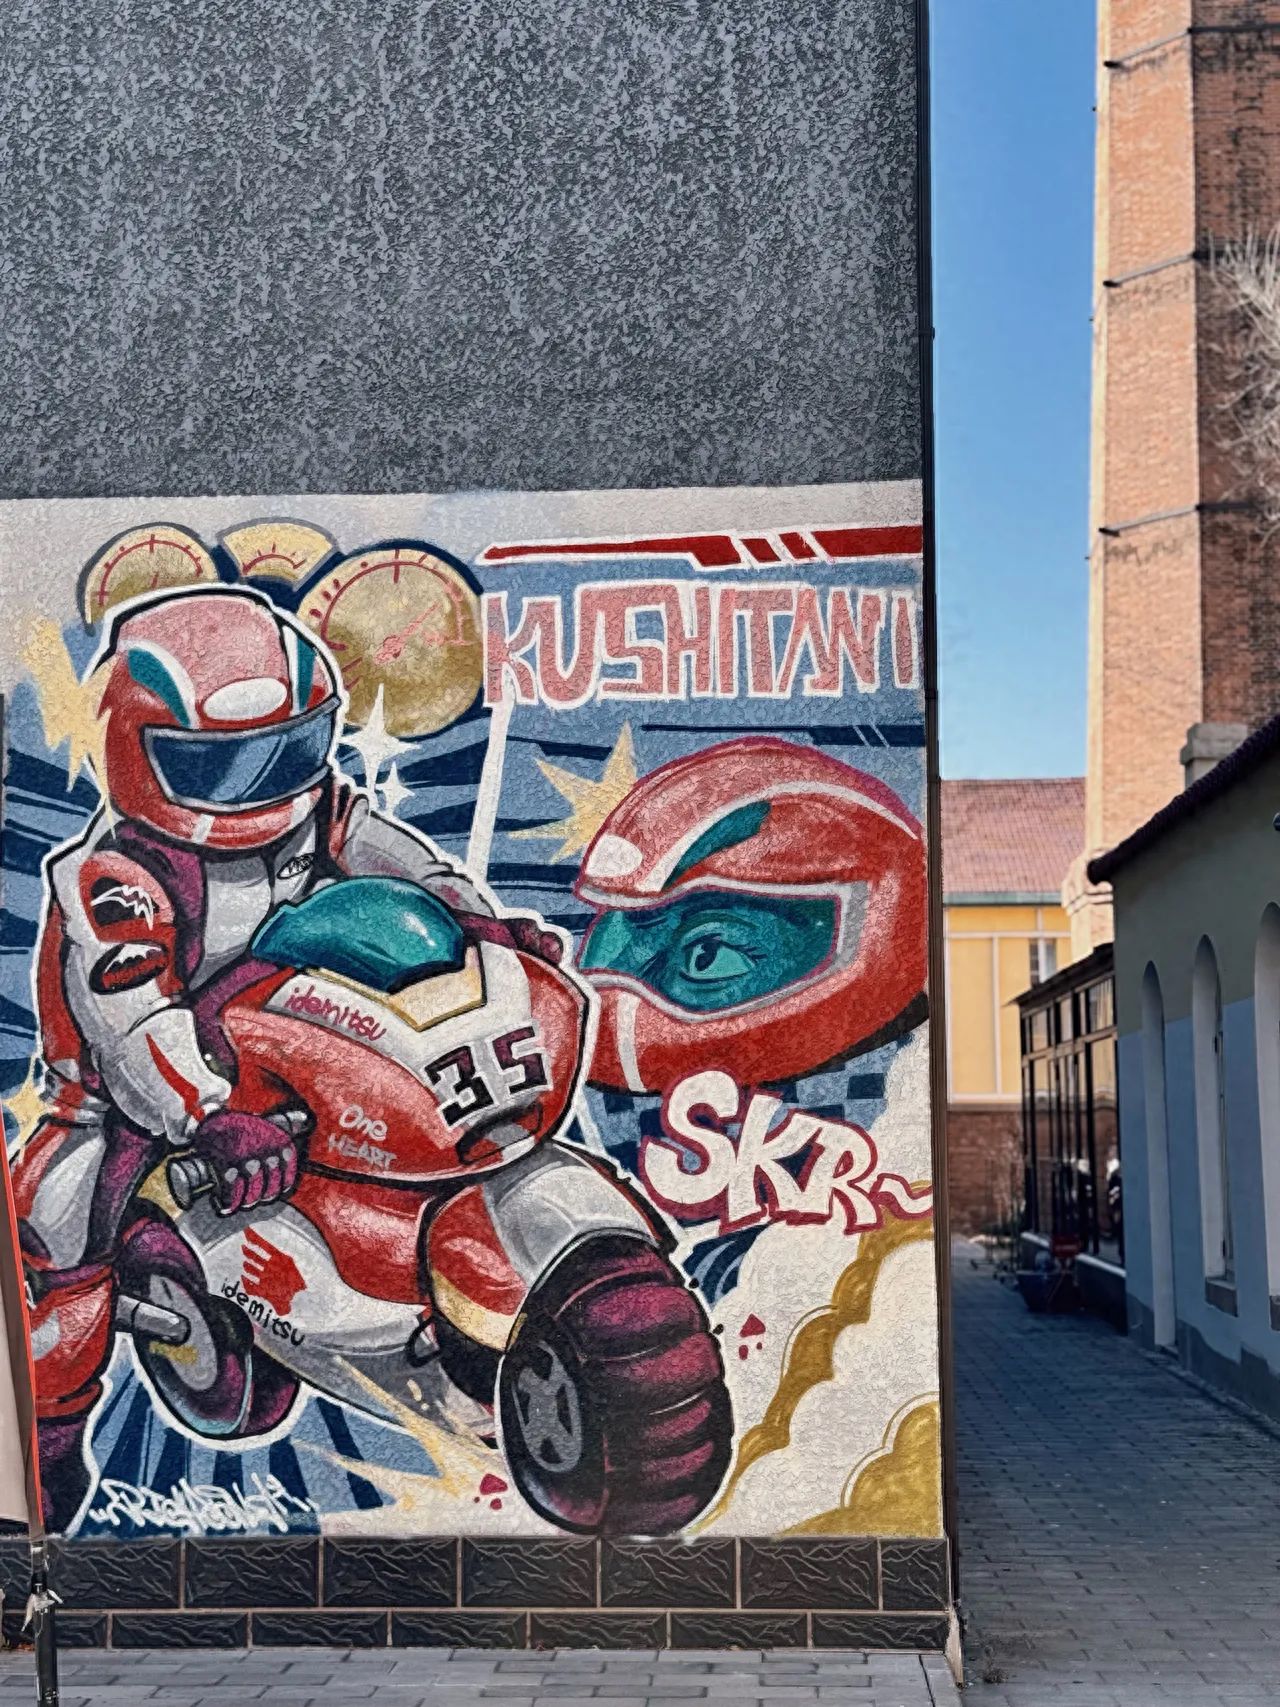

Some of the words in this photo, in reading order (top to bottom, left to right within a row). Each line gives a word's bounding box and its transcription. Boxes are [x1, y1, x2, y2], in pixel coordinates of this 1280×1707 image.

[483, 580, 922, 709] KUSHITANI
[422, 1023, 550, 1129] 35
[327, 1133, 397, 1171] HEART
[339, 1104, 388, 1142] One
[640, 1067, 884, 1233] SKR
[220, 1277, 306, 1346] idemitsu
